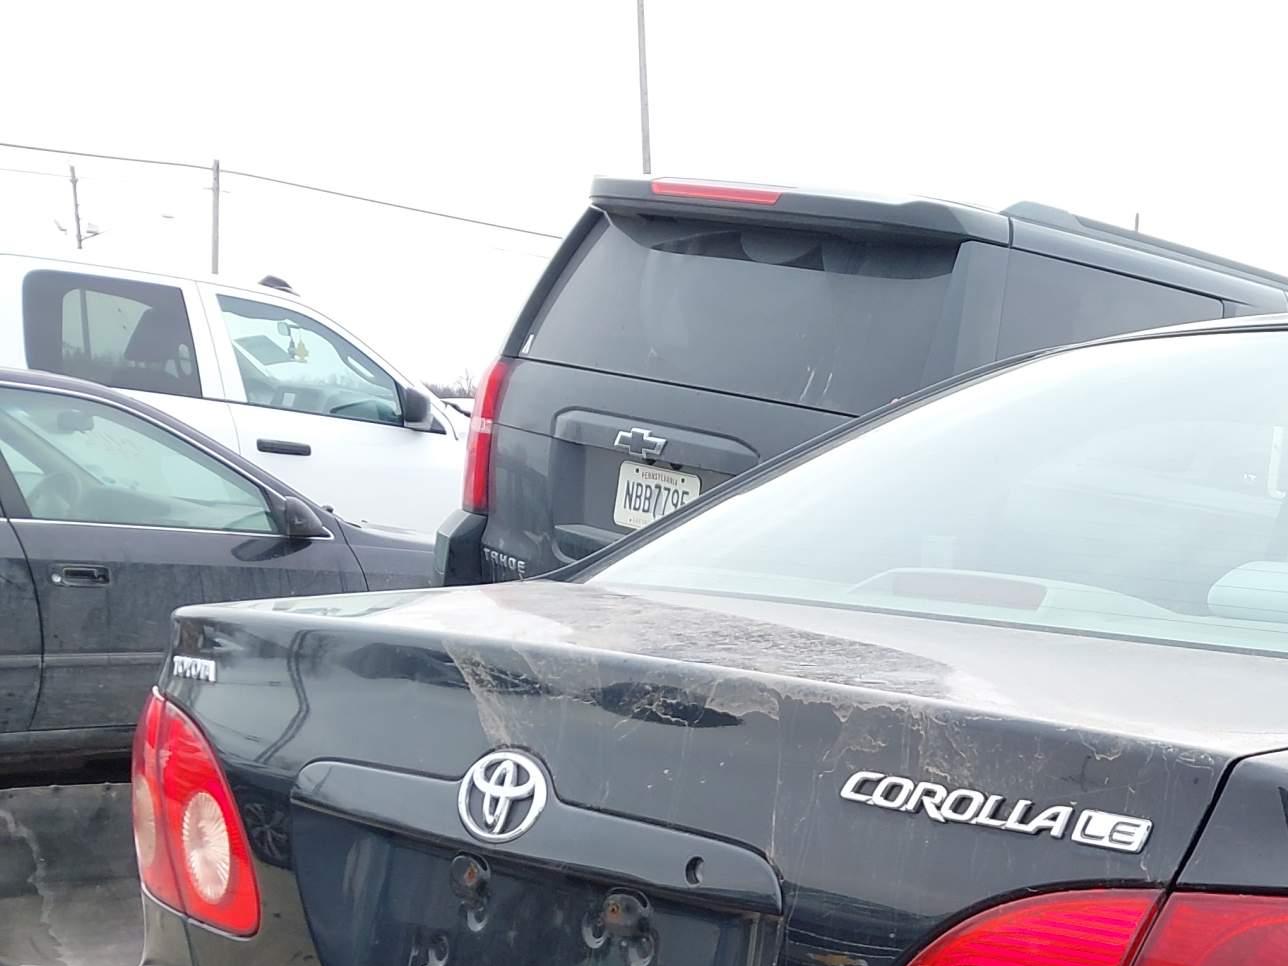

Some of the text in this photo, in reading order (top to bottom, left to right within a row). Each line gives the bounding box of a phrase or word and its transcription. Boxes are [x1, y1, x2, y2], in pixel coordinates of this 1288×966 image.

[483, 547, 525, 573] TAHOE
[173, 655, 216, 682] TOYOTA
[840, 770, 1145, 850] COROLLA LE
